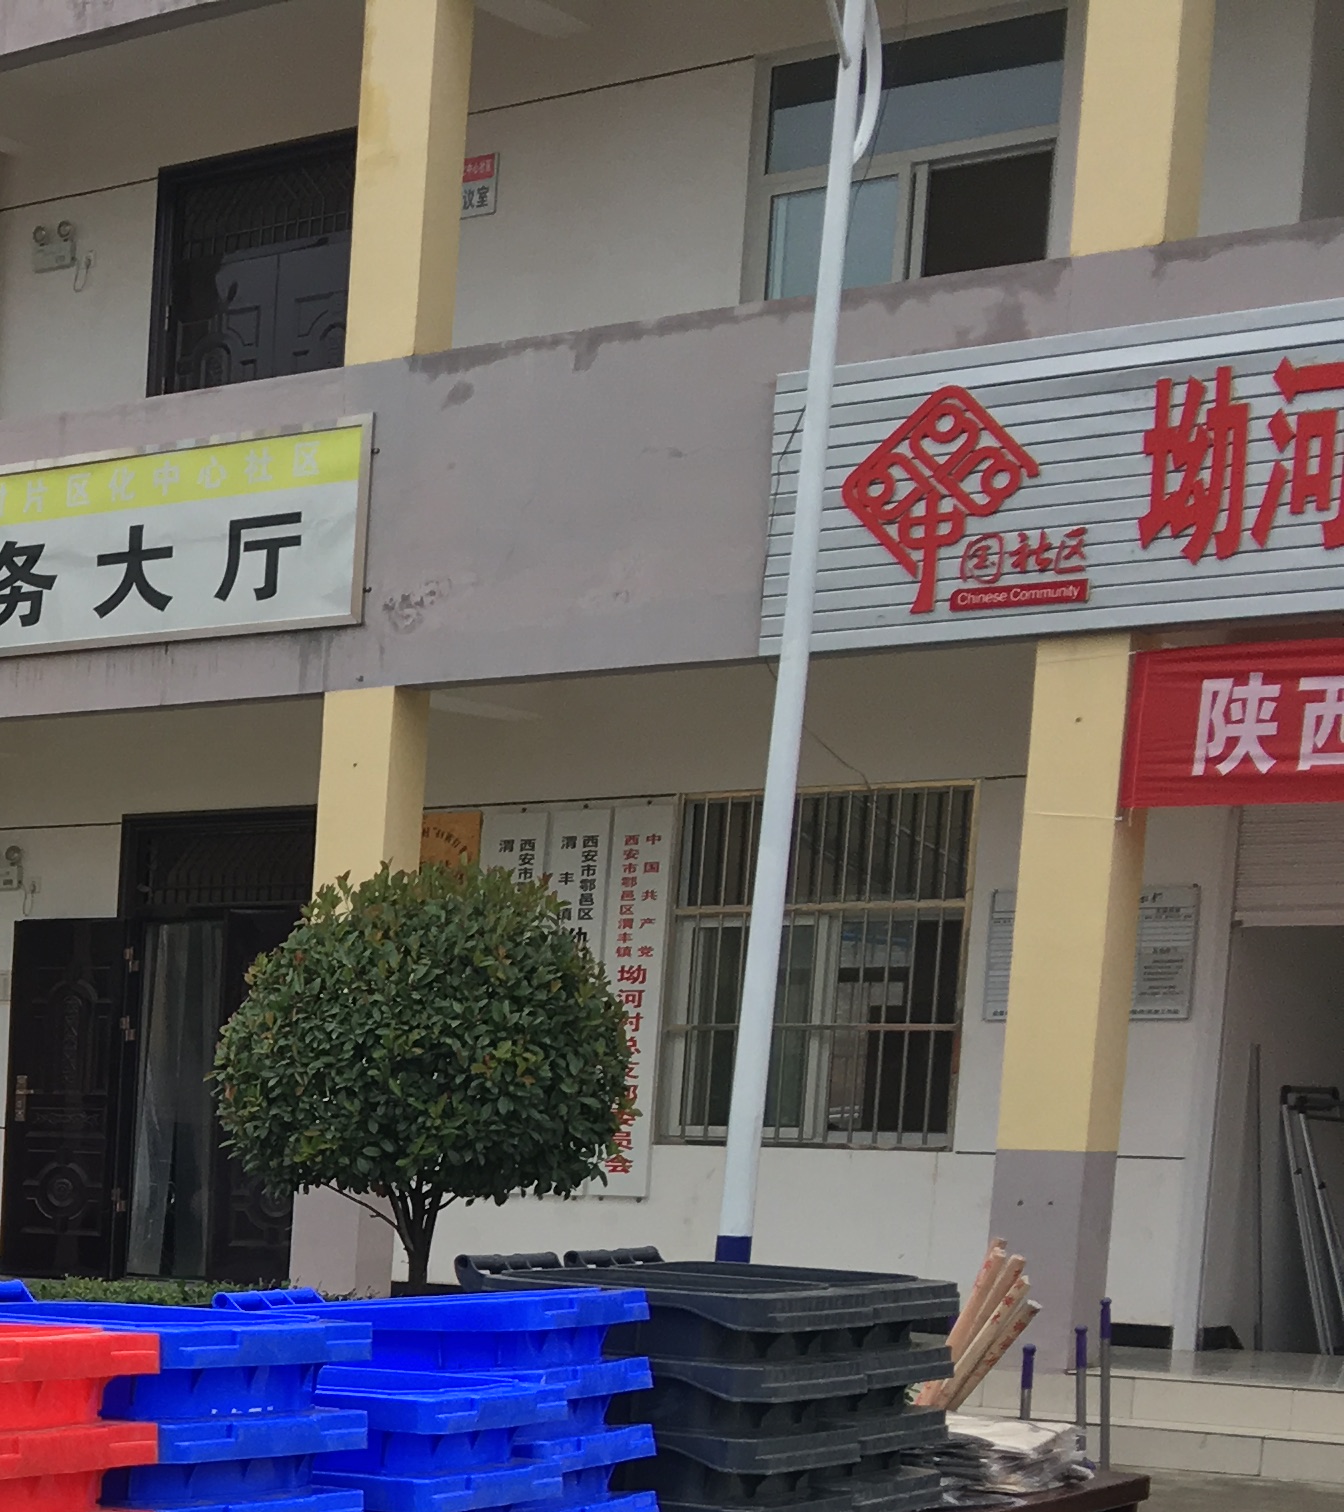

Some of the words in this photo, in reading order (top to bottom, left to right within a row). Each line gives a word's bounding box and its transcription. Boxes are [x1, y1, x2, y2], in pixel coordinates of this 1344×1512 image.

[1137, 356, 1344, 565] 坳河
[957, 589, 1008, 607] Chinese
[1010, 583, 1081, 603] Community
[1191, 671, 1344, 776] 陕西
[517, 838, 536, 889] 西安市
[637, 833, 662, 958] 中国共产党
